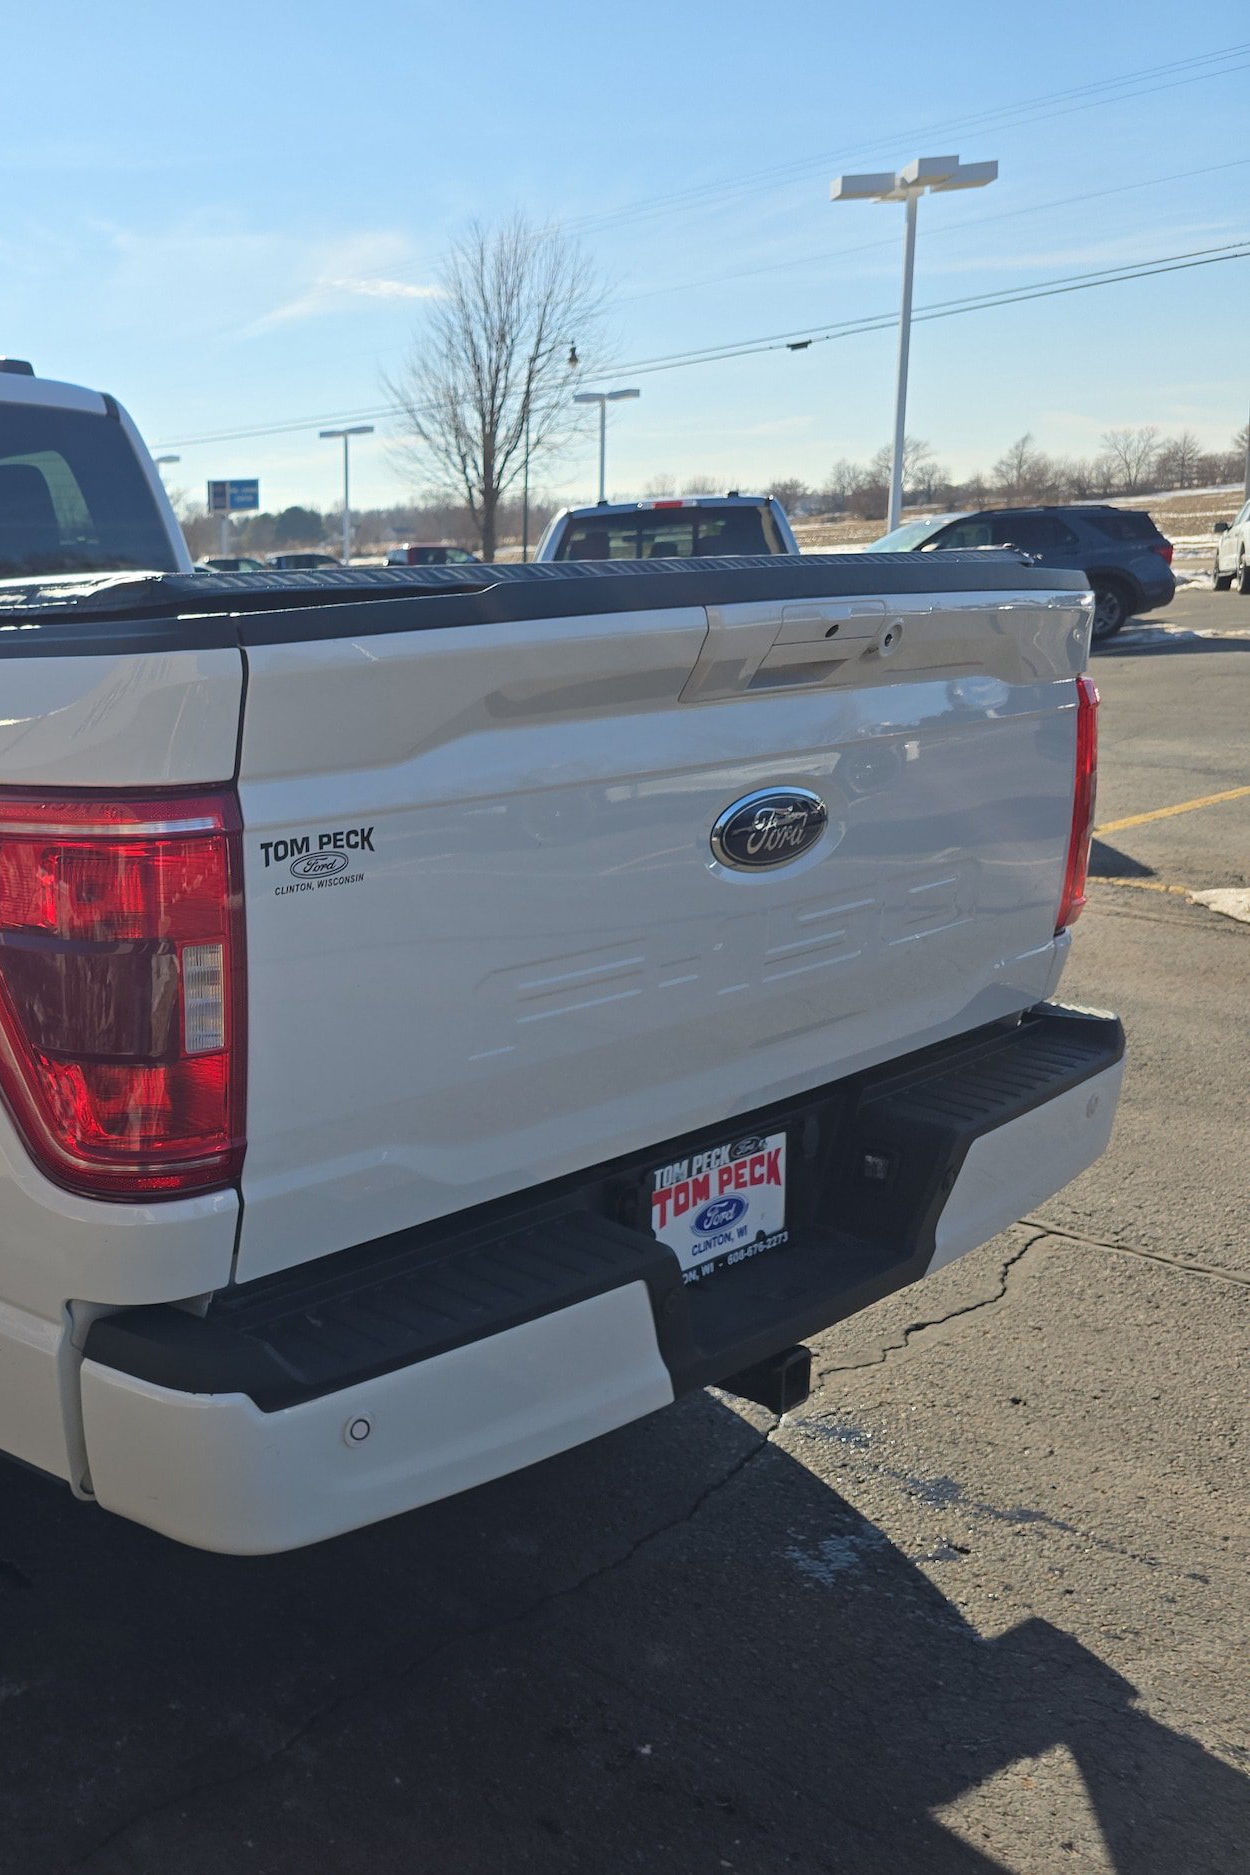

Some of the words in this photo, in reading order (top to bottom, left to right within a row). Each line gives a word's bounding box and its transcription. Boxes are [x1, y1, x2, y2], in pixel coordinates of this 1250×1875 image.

[746, 806, 809, 855] Ford
[260, 836, 310, 868] TOM
[318, 826, 375, 852] PECK
[303, 857, 337, 873] Ford
[274, 881, 315, 896] CLINTON,
[317, 873, 365, 889] WISCONSIN
[654, 1159, 689, 1190] TOM
[692, 1143, 732, 1175] PECK
[652, 1171, 710, 1229] TOM
[717, 1148, 782, 1196] PECK
[703, 1201, 736, 1230] Ford
[692, 1233, 735, 1257] CLINTON,
[736, 1225, 748, 1239] WI
[701, 1262, 715, 1277] WI
